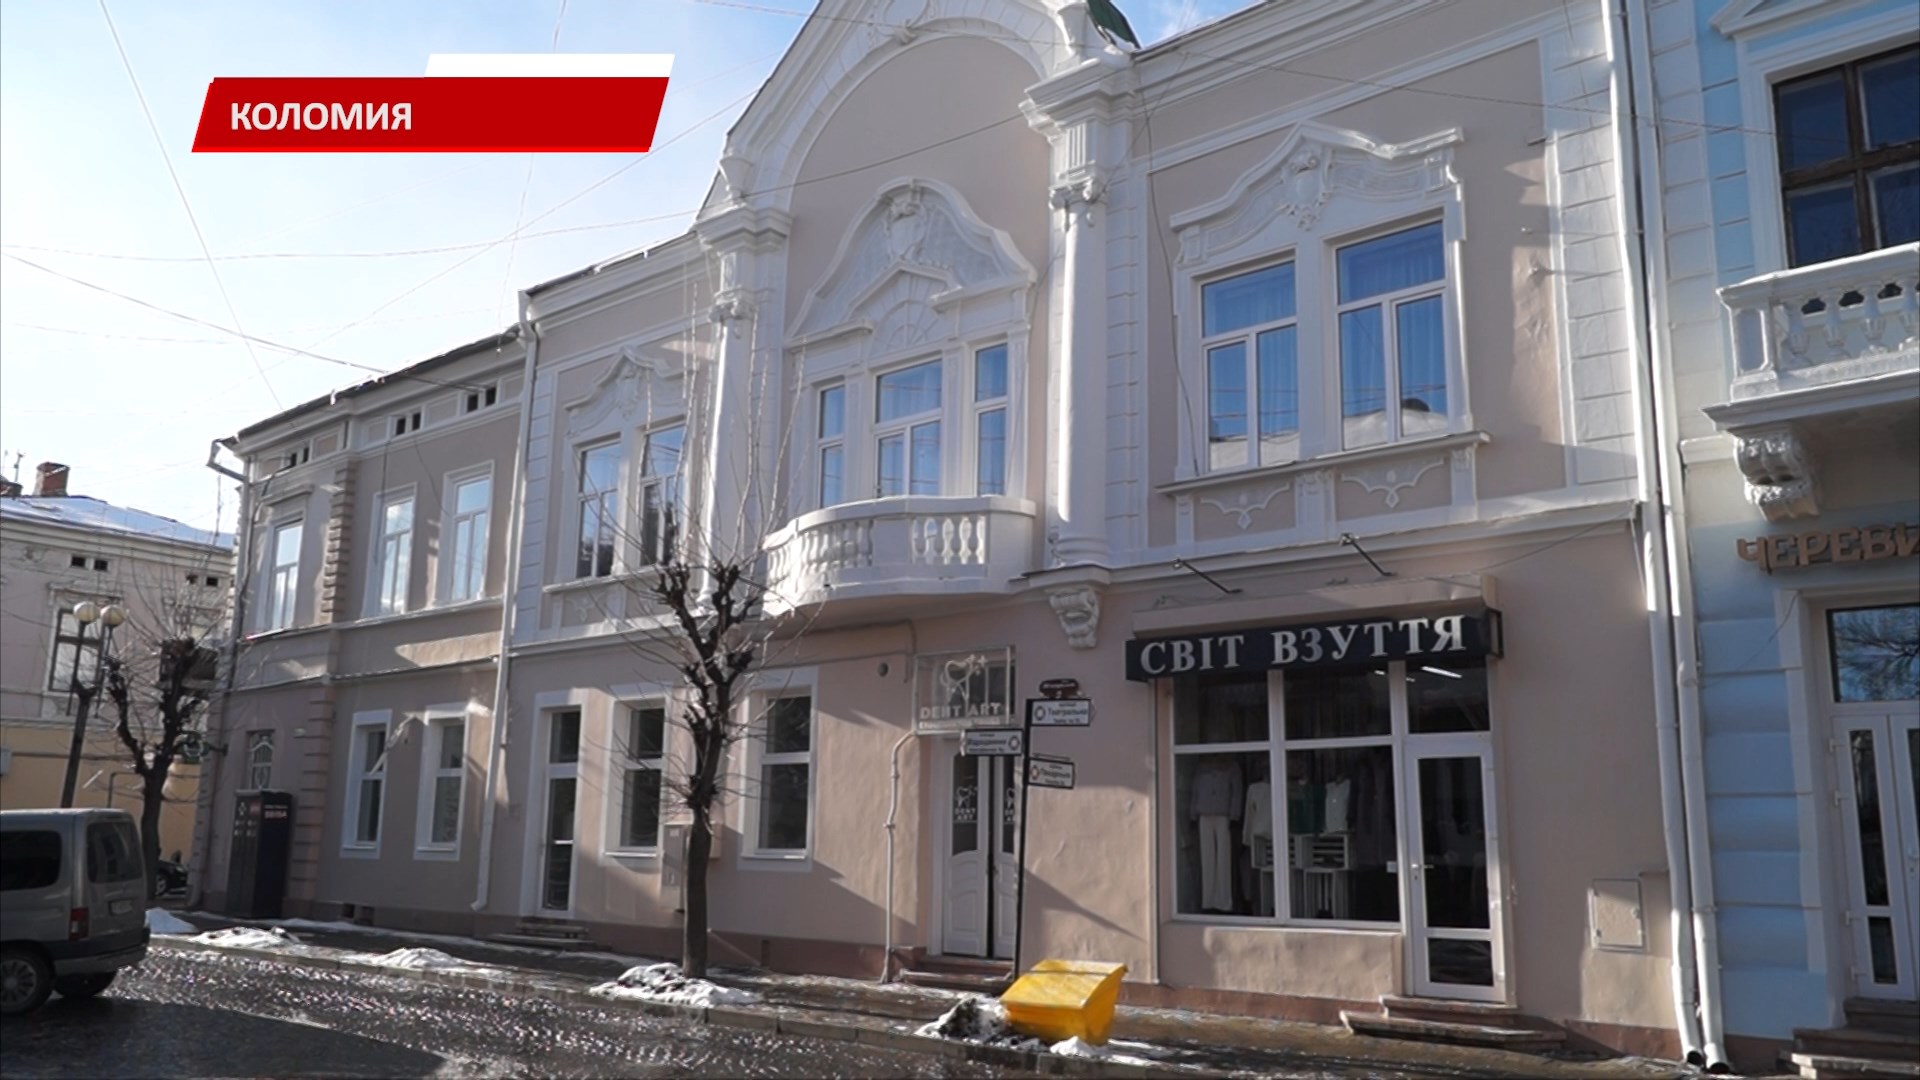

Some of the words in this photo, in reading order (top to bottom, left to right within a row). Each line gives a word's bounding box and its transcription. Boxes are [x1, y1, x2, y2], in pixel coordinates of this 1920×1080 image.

[1140, 635, 1245, 675] СВІТ
[1271, 614, 1467, 664] ВЗУТТЯ
[968, 702, 1001, 717] ART
